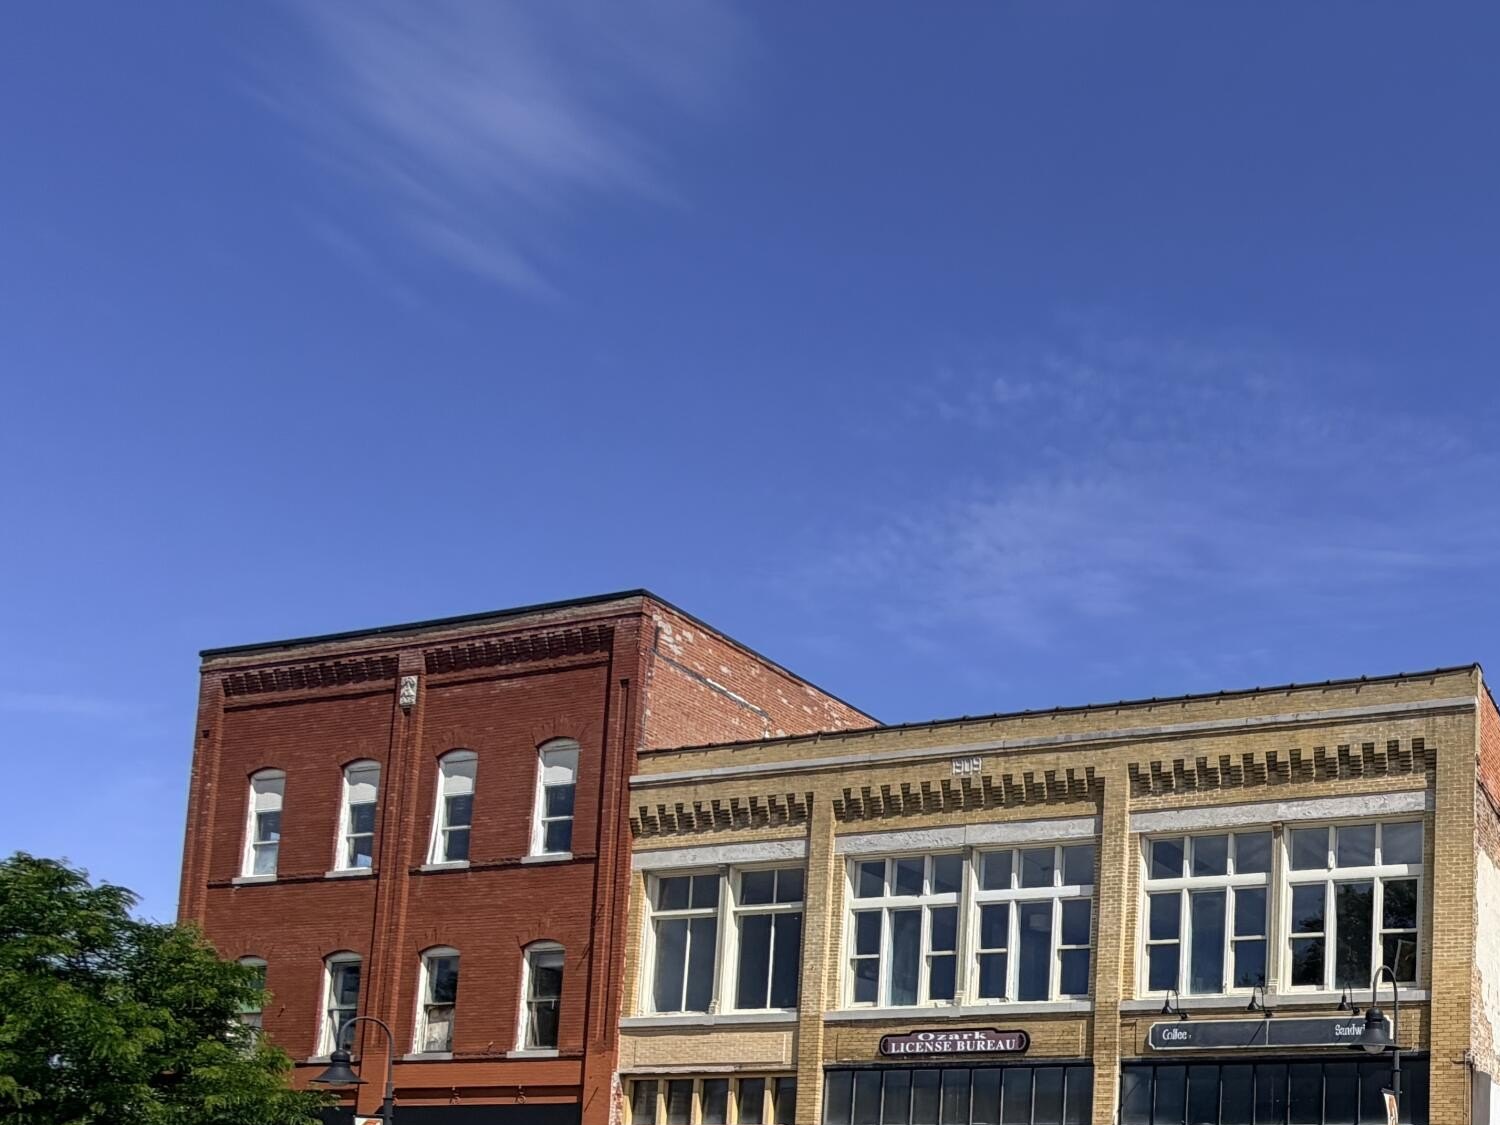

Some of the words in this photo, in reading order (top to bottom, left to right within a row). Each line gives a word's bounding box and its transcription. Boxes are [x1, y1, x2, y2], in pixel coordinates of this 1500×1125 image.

[952, 756, 982, 775] 1909
[917, 1031, 987, 1041] Ozark
[1162, 1028, 1187, 1040] Coffee
[1335, 1023, 1366, 1036] Sandwi
[891, 1041, 951, 1053] LICENSE
[956, 1039, 1016, 1051] BUREAU
